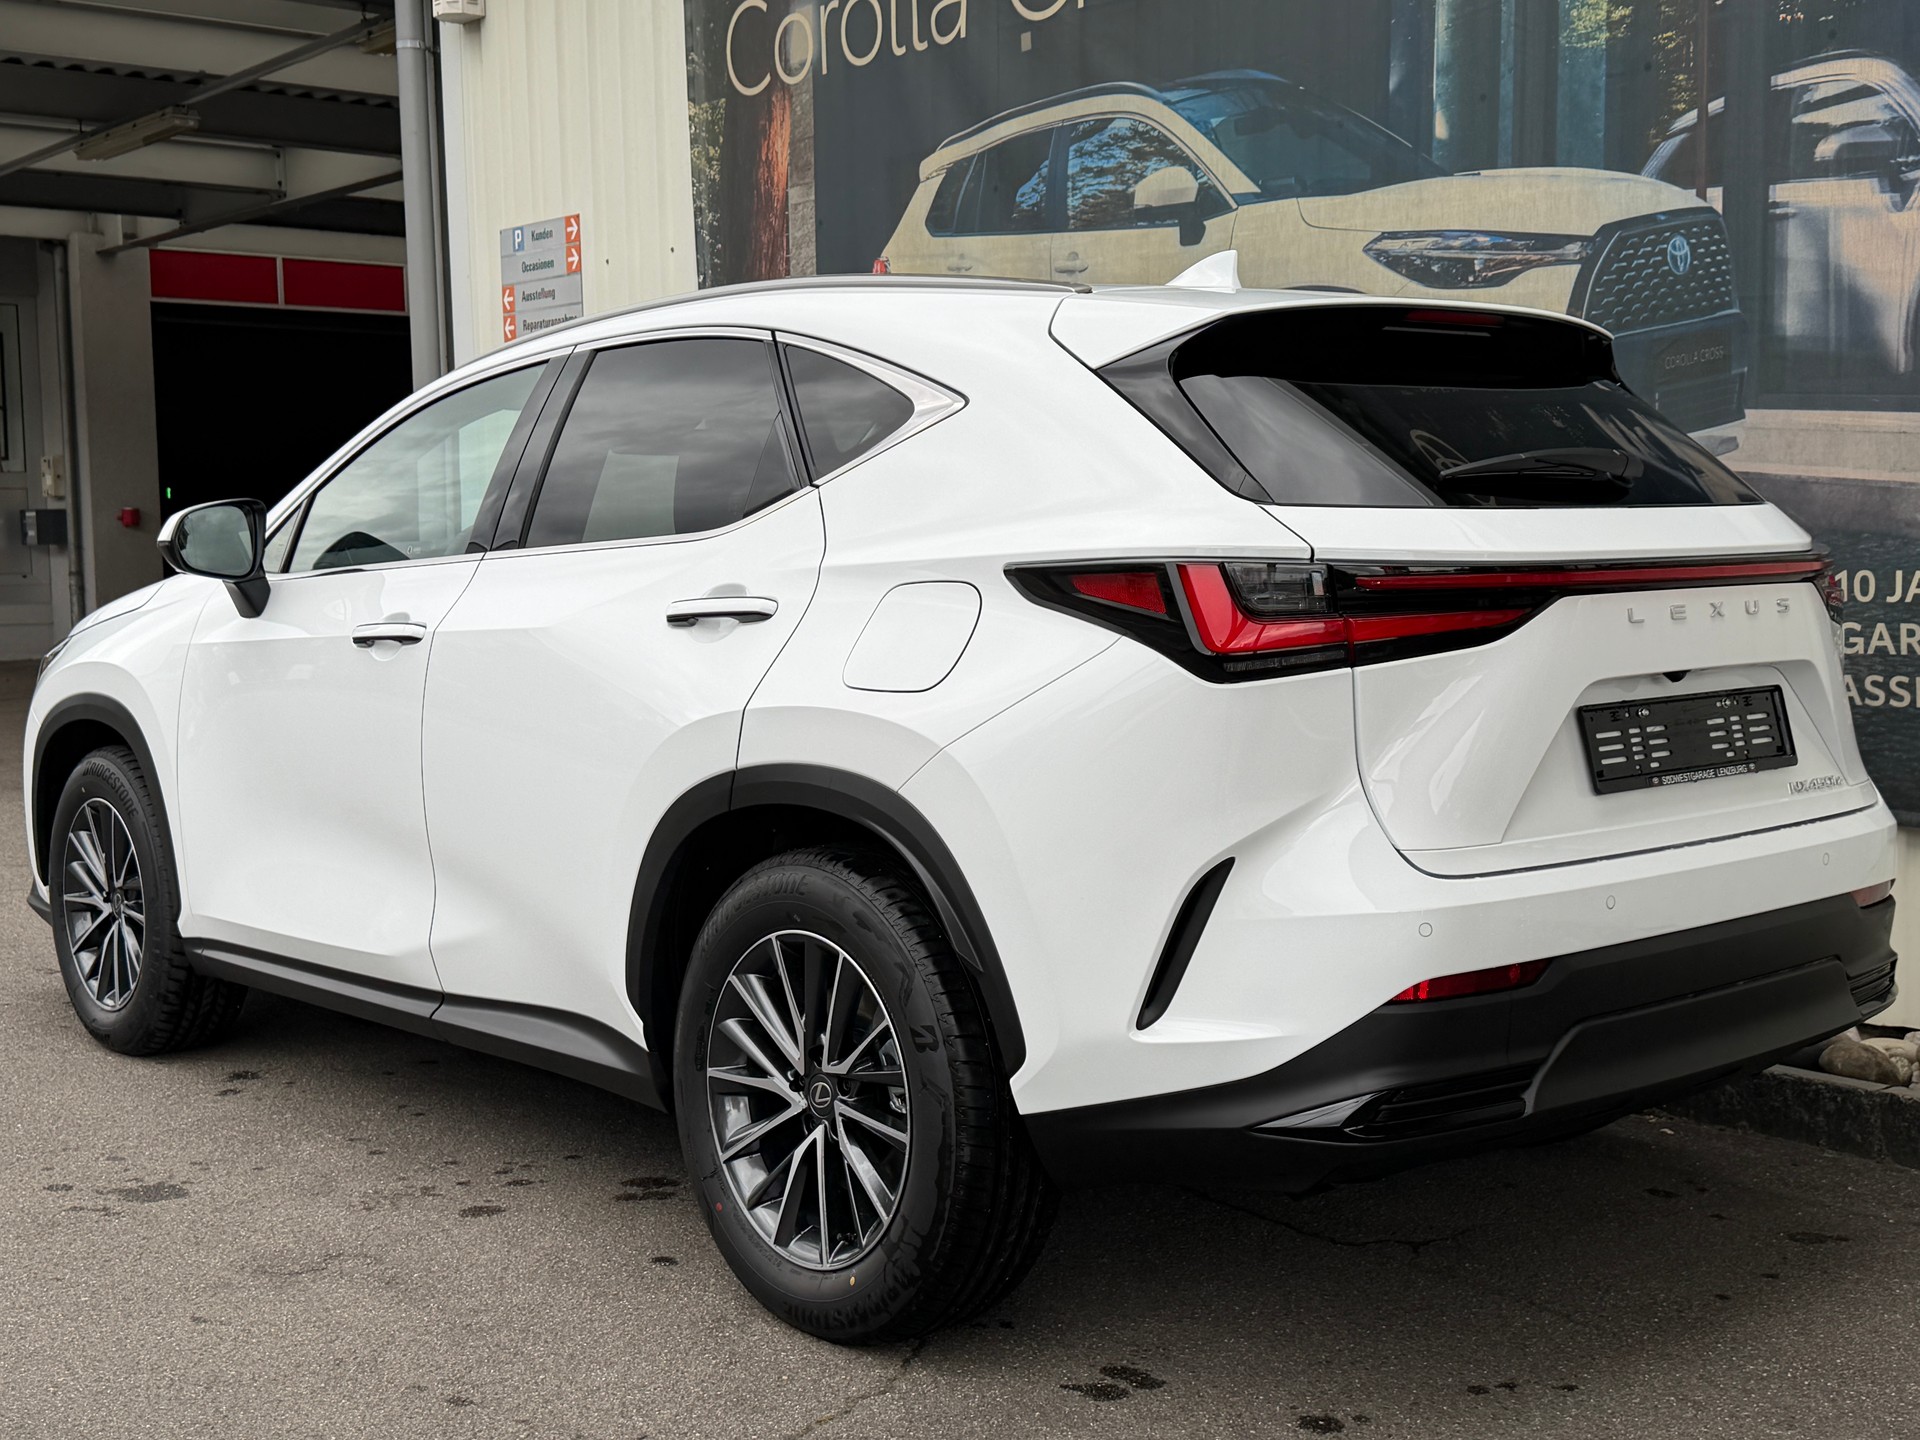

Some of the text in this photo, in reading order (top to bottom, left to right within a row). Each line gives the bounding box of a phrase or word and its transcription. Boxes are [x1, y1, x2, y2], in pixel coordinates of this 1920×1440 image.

[726, 0, 967, 96] Corolla
[531, 228, 553, 241] Kunden
[522, 259, 554, 273] Occasionen
[522, 288, 555, 302] Ausstellung
[1665, 346, 1724, 369] COROLLA CROSS
[1834, 570, 1876, 603] 10
[1627, 598, 1791, 624] LEXUS
[1842, 622, 1920, 656] GAR
[1716, 764, 1748, 777] LENZBURG
